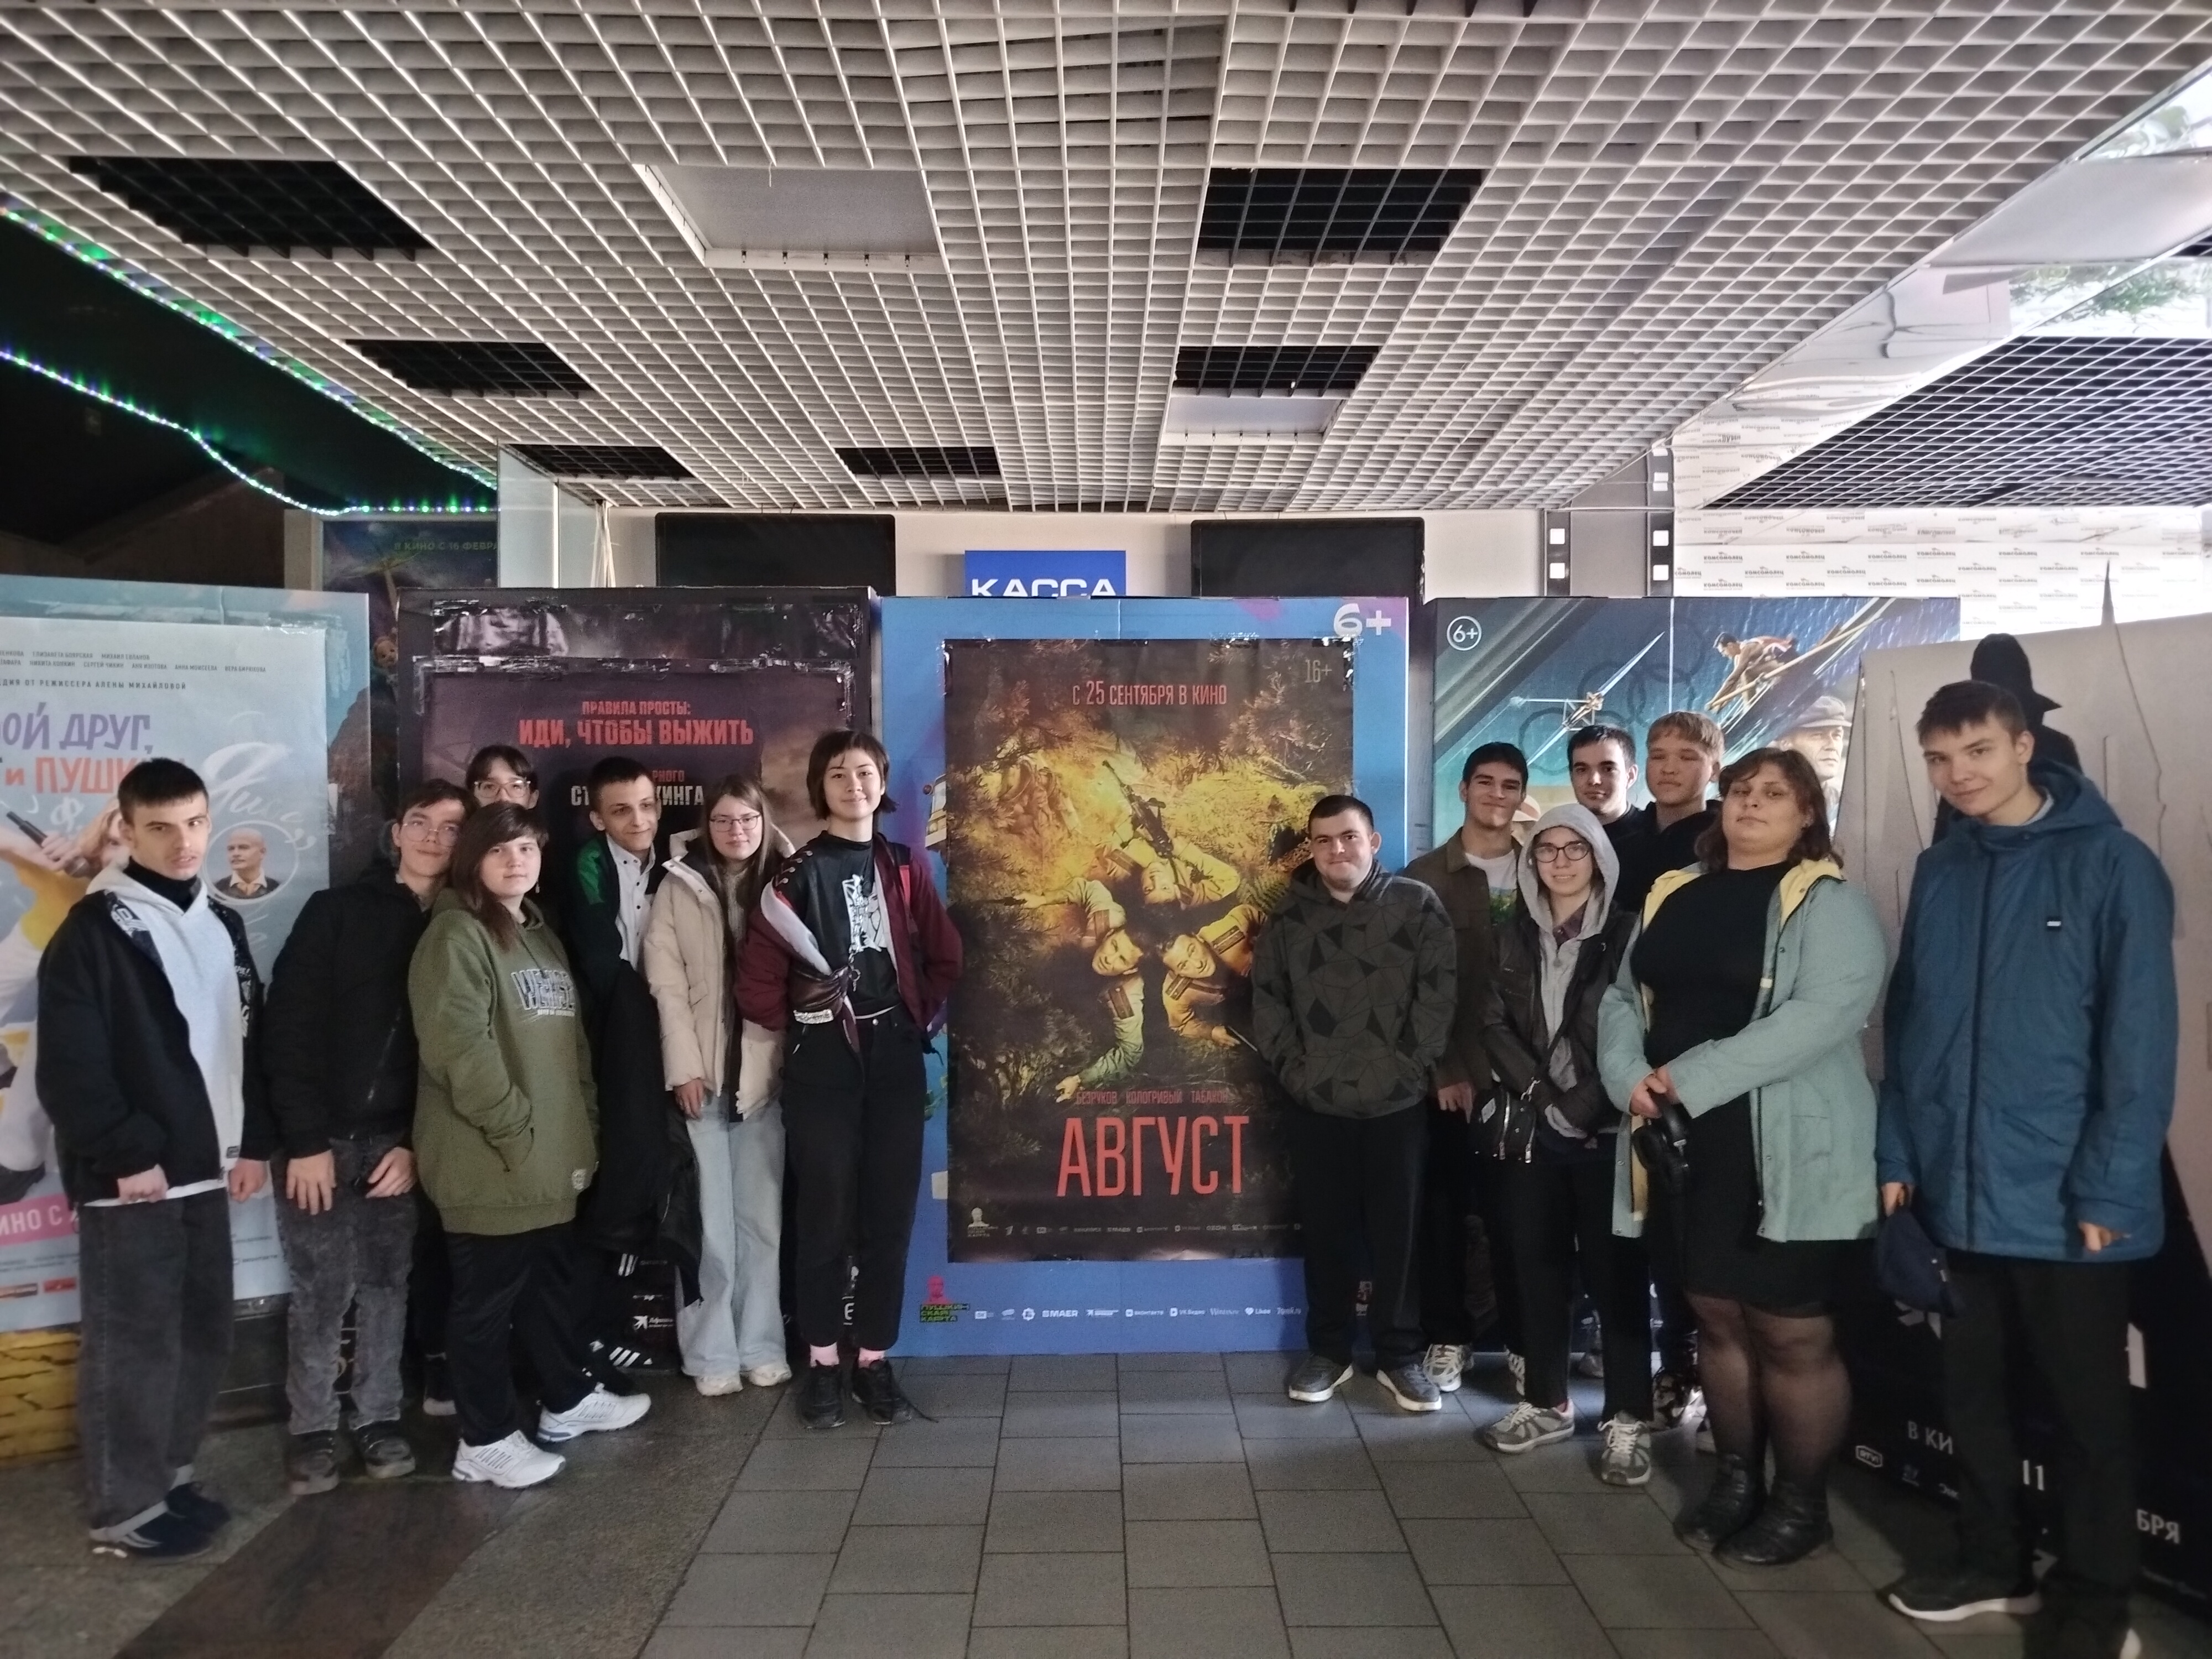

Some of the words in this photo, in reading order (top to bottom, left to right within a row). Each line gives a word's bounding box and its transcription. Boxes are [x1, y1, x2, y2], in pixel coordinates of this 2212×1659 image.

[971, 578, 1118, 597] КАССА
[1334, 603, 1391, 638] 6+
[1453, 624, 1478, 643] 6+
[1305, 659, 1332, 683] 16+
[40, 680, 91, 688] РЕЖИССЕРА
[129, 681, 186, 690] МИХАЙЛОВОЙ
[1072, 685, 1081, 706] С
[1086, 681, 1105, 706] 25
[1109, 685, 1174, 706] СЕНТЯБРЯ
[1178, 685, 1187, 705] В
[1192, 685, 1227, 706] КИНО
[582, 701, 636, 715] ПРАВИЛА
[639, 701, 691, 716] ПРОСТЫ:
[0, 702, 50, 750] ОЙ
[59, 713, 154, 754] ДРУГ,
[518, 719, 571, 748] ИДИ,
[577, 719, 653, 745] ЧТОБЫ
[659, 719, 754, 745] ВЫЖИТЬ
[653, 770, 685, 782] РНОГО
[1076, 1091, 1118, 1104] БЕЗРУКОВ
[1125, 1089, 1182, 1104] КОЛОГРИВЫЙ
[1056, 1115, 1250, 1197] АВГУСТ
[0, 1209, 42, 1236] ИНО
[1908, 1420, 1919, 1439] В
[1926, 1427, 1953, 1455] КИ
[2136, 1508, 2180, 1545] БРЯ
